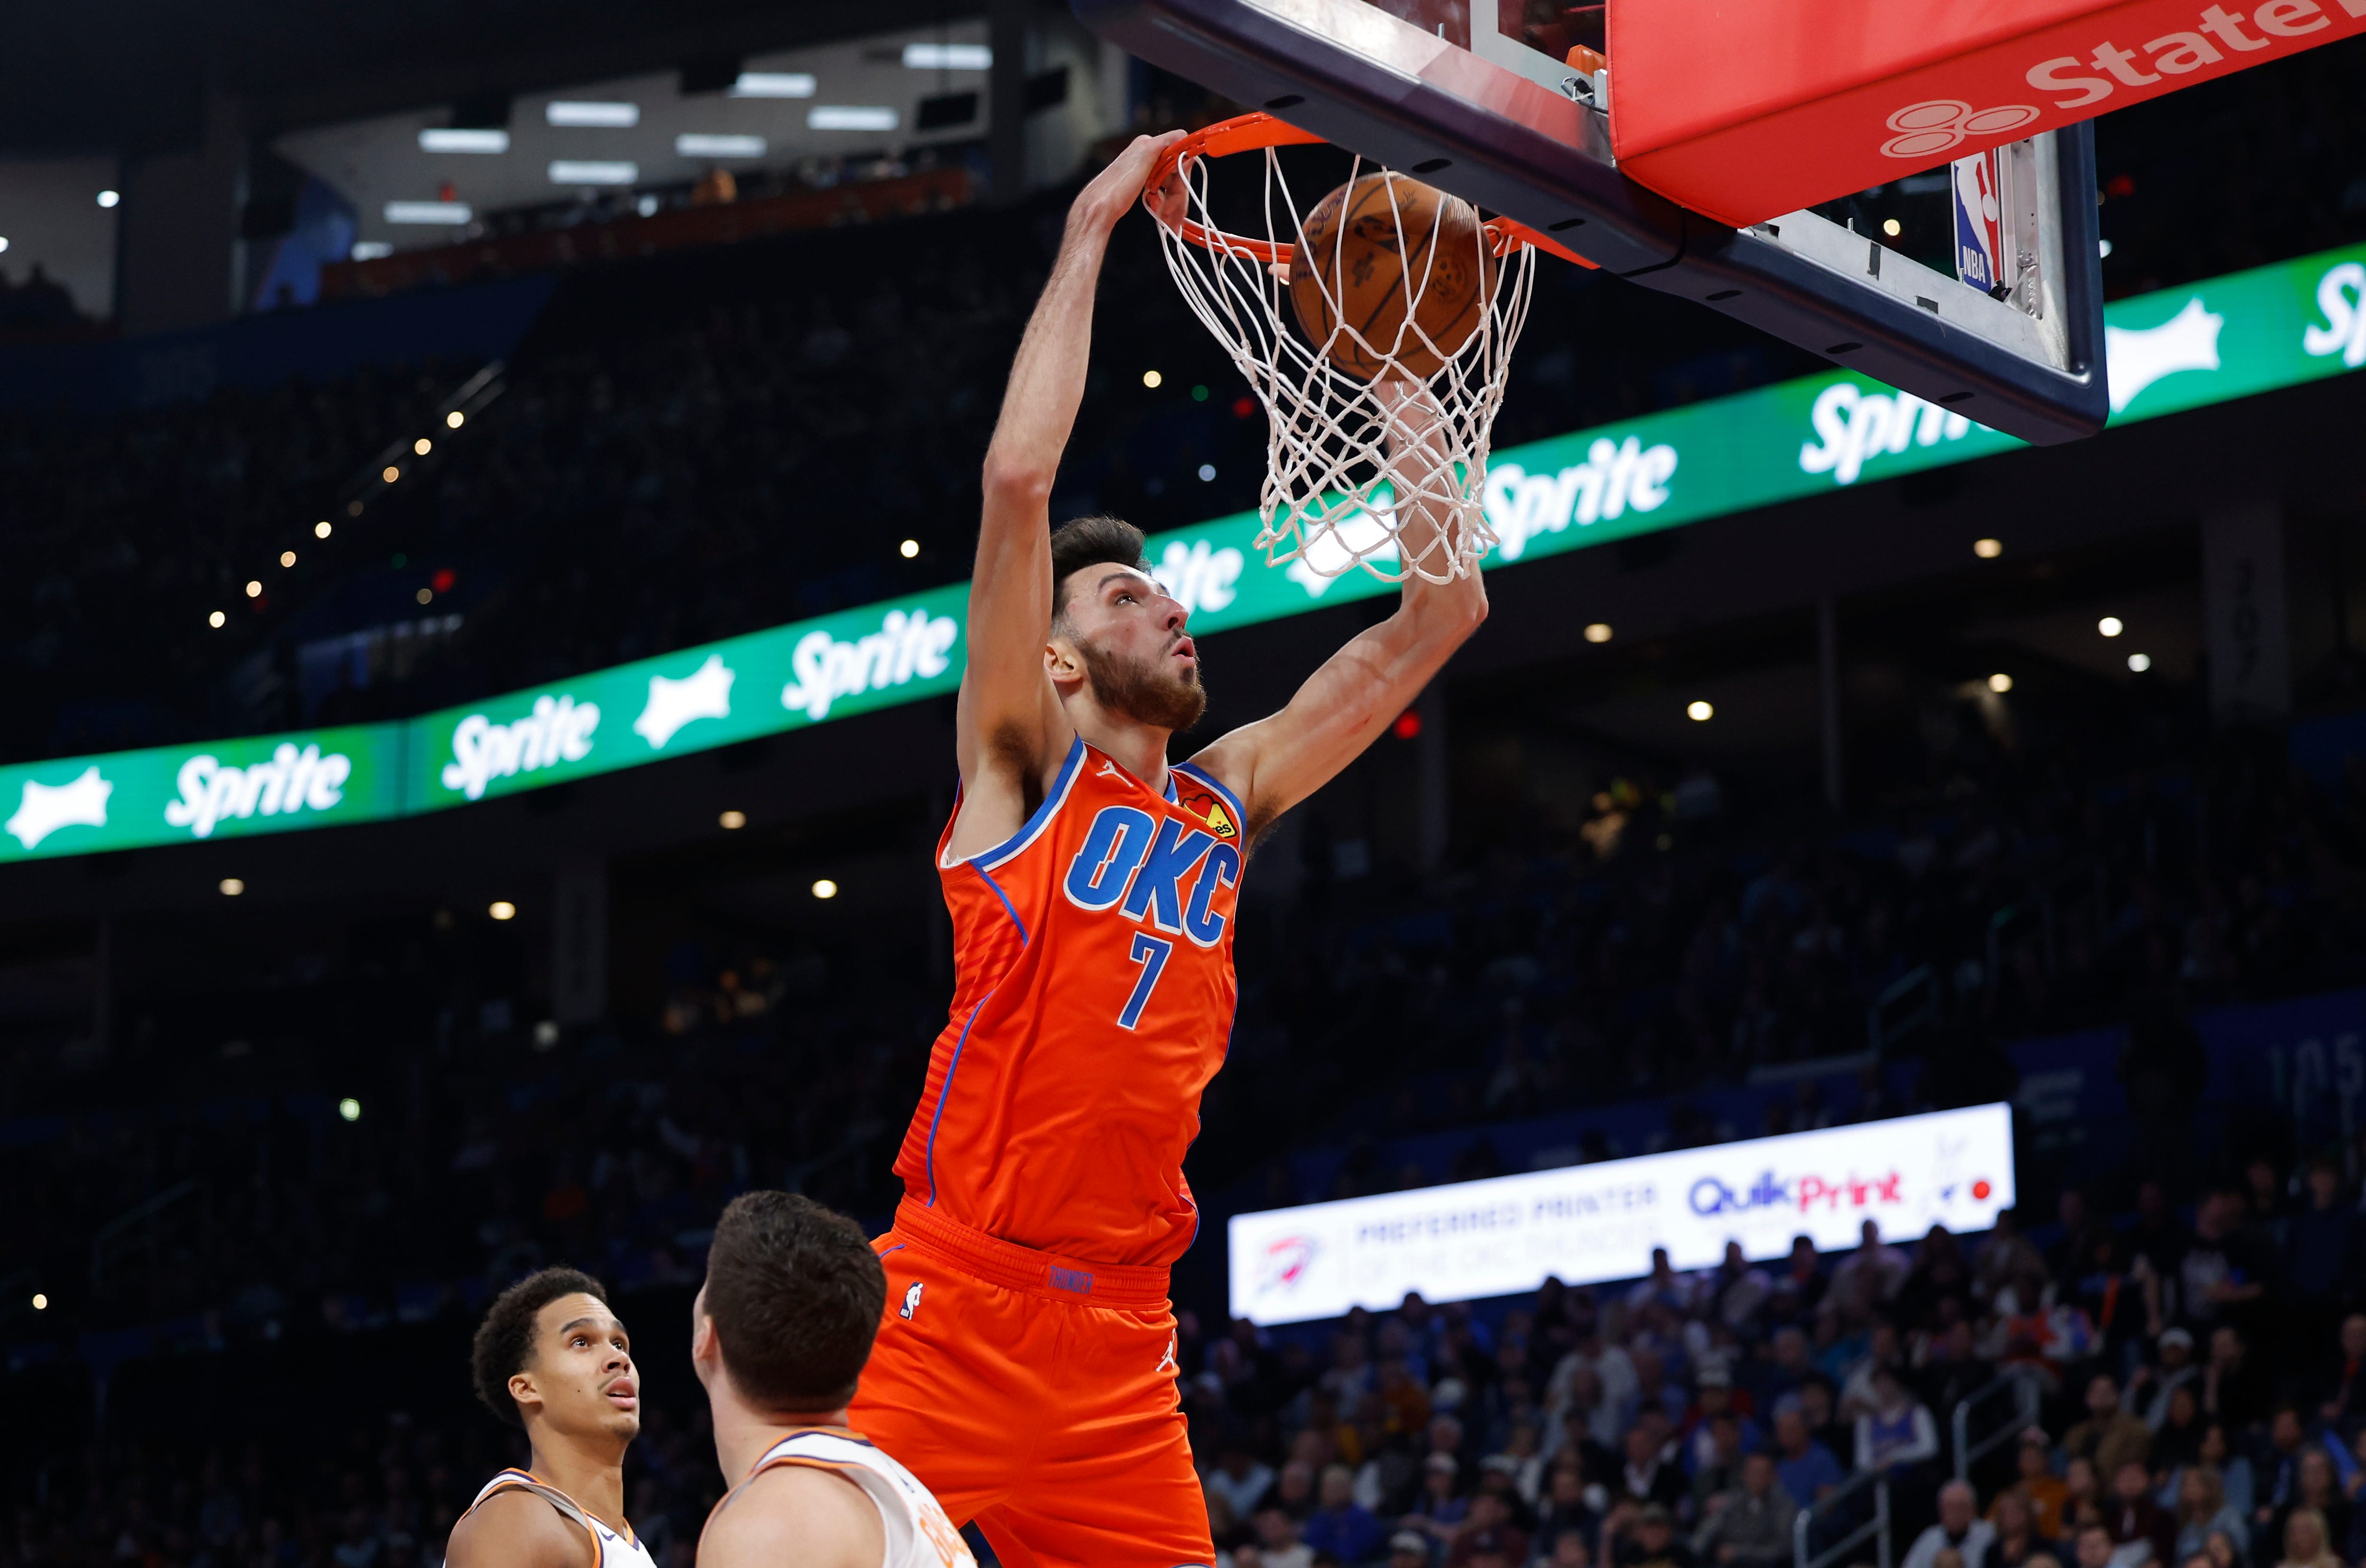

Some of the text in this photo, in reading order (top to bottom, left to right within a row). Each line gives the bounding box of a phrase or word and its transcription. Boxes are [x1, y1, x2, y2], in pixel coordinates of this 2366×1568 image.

[2026, 0, 2330, 109] State
[1963, 245, 1986, 284] NBA
[1473, 434, 1678, 562] Sprite
[781, 609, 957, 720] Sprite
[164, 742, 351, 838] Sprite
[442, 695, 601, 800] Sprite
[1063, 805, 1241, 948] OKC
[1116, 930, 1173, 1031] 7
[1689, 1169, 1901, 1216] QuikPrint
[1048, 1265, 1093, 1294] THUNDER
